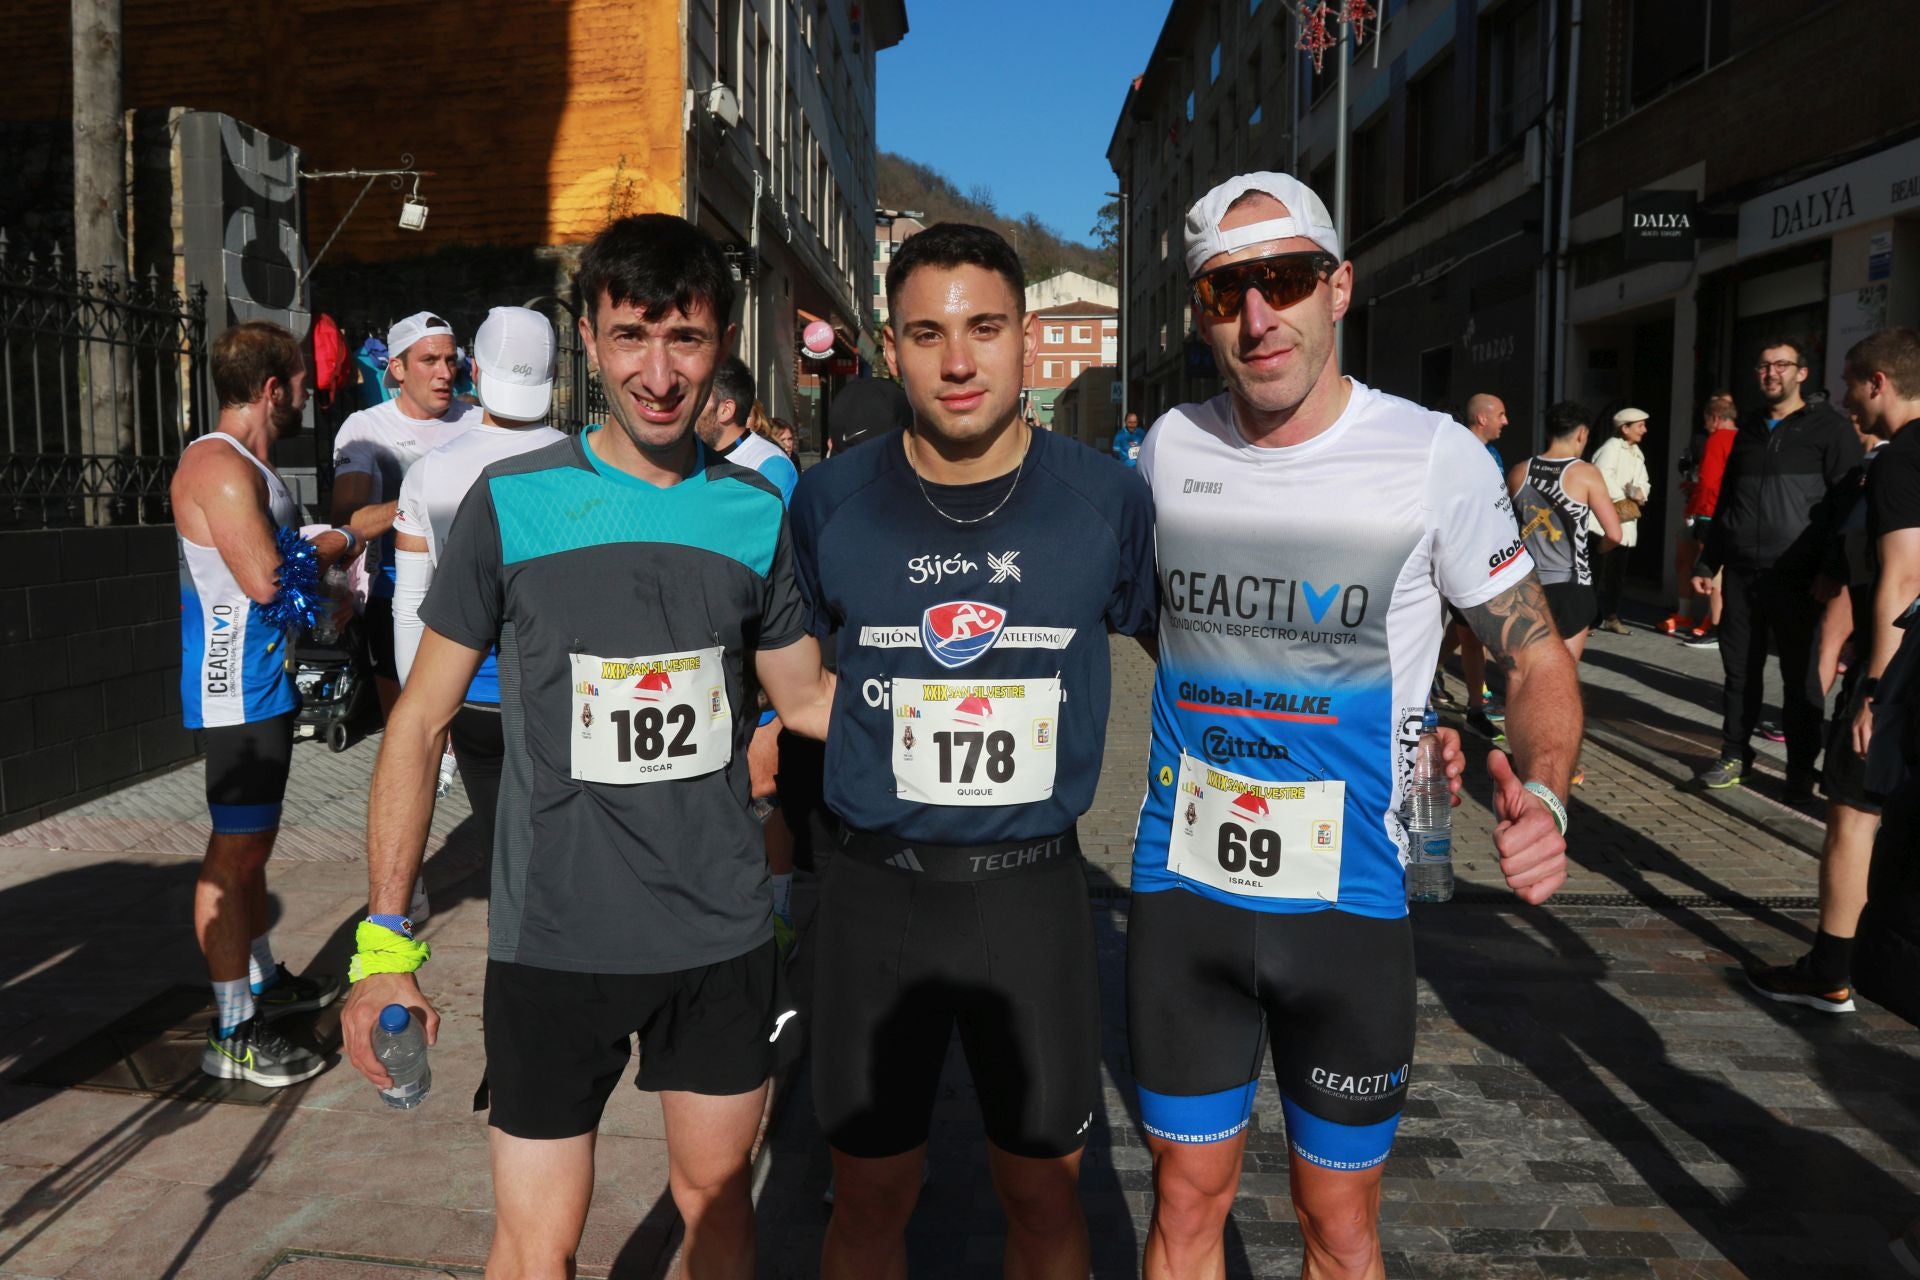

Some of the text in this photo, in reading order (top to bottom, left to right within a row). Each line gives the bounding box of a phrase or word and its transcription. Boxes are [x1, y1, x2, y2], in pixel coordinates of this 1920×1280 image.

[1633, 213, 1690, 228] DALYA
[1771, 182, 1855, 240] DALYA
[908, 552, 978, 585] gijón
[1489, 539, 1524, 568] Glob
[1168, 569, 1369, 628] CEACTIVO
[207, 604, 233, 694] CEACTIVO
[872, 628, 1060, 645] GIJÓN ATLETISMO
[1227, 623, 1298, 641] ESPECTRO
[1301, 630, 1357, 645] AUTISTA
[601, 656, 700, 680] XXIX SAN SILVESTRE
[923, 685, 1026, 701] XXIX SAN SILVESTRE
[1178, 681, 1331, 715] Global-TALKE
[610, 703, 697, 762] 182
[639, 763, 672, 773] OSCAR
[933, 730, 1015, 783] 178
[957, 788, 993, 796] QUIQUE
[1207, 769, 1305, 800] XXIX SAN SILVESTRE
[969, 836, 1065, 873] TECHFIT
[1218, 822, 1281, 878] 69
[1229, 876, 1264, 888] ISRAEL
[1311, 1064, 1409, 1094] CEACTIVO
